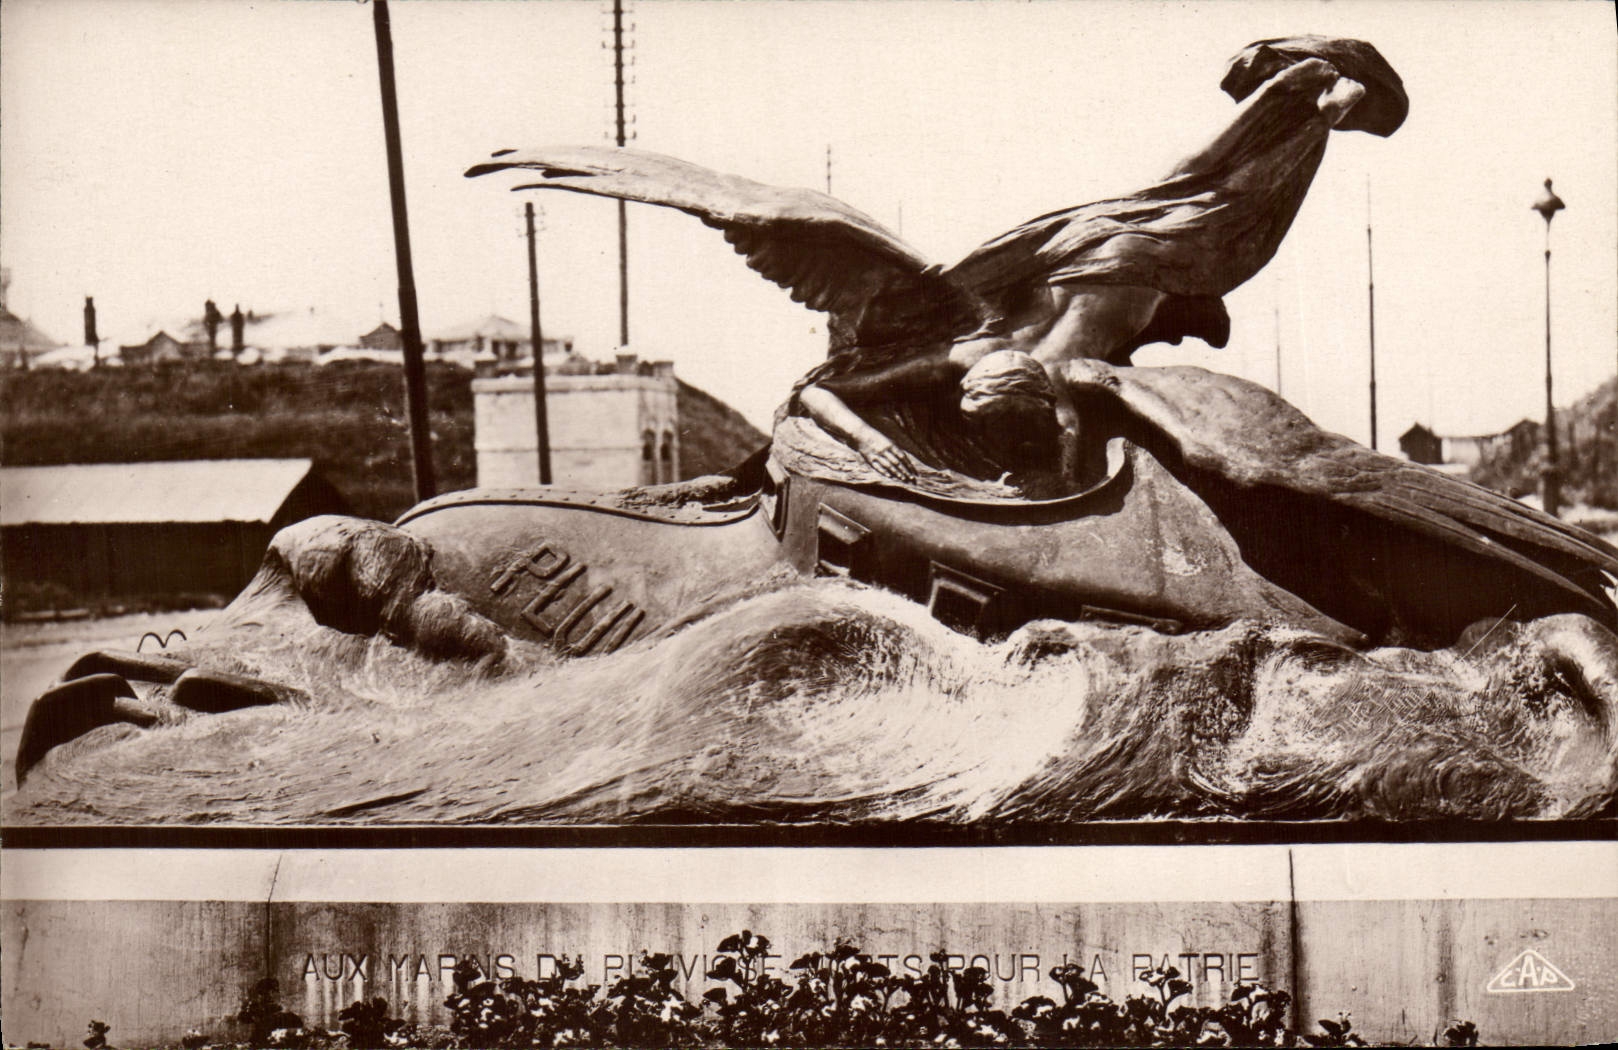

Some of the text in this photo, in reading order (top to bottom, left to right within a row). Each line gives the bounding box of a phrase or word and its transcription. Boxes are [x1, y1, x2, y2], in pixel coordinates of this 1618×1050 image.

[302, 953, 368, 981] AUX
[389, 953, 516, 981] MARNS
[944, 953, 1041, 982] POUR
[1059, 953, 1108, 982] A
[1132, 953, 1260, 982] PATRIE
